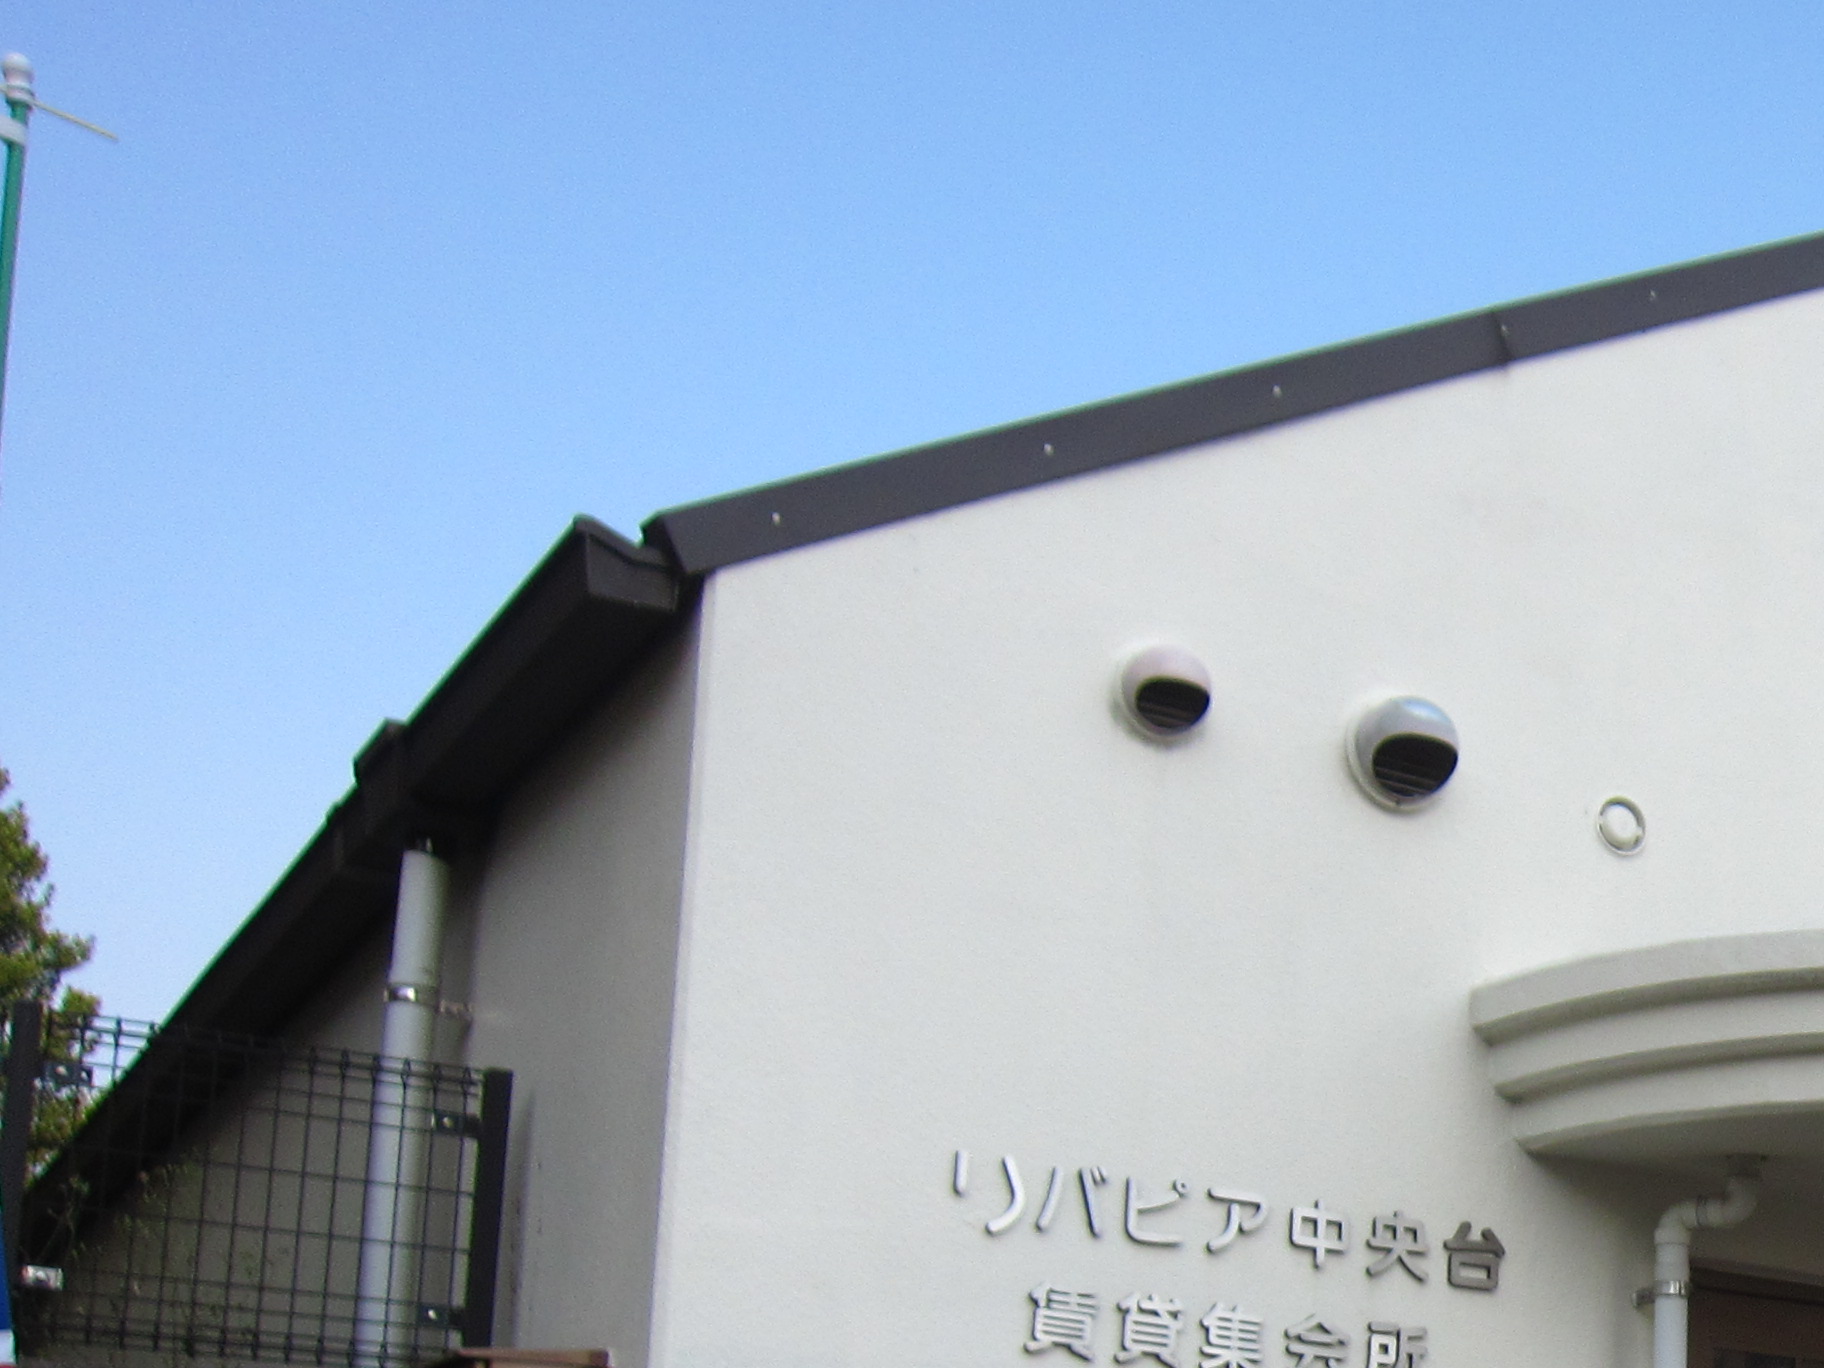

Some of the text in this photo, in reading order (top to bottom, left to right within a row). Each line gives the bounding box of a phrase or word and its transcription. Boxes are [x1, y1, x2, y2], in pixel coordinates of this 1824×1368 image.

[952, 1149, 1507, 1292] リバピア中央台
